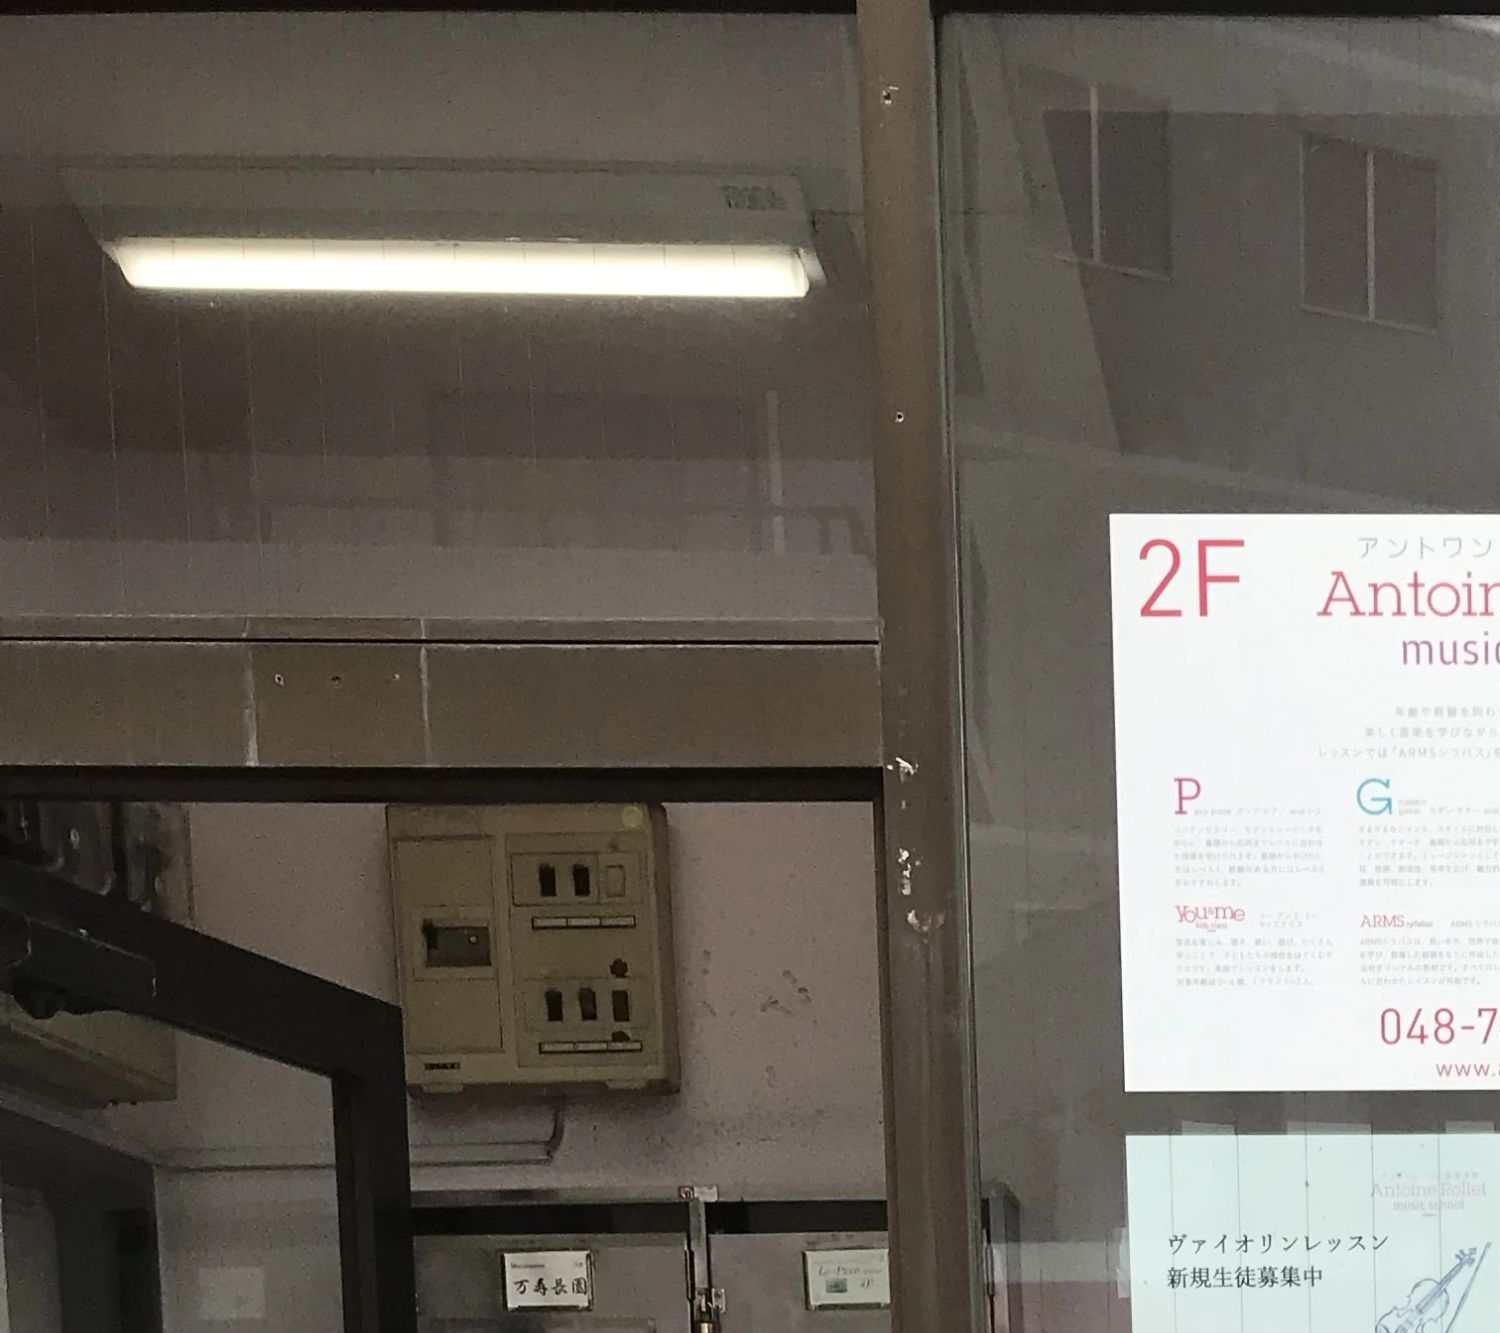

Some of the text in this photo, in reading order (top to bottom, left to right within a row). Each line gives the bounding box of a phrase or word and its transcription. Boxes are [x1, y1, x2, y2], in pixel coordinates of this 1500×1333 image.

[1138, 538, 1245, 619] 2F
[1174, 778, 1201, 815] P
[1356, 778, 1393, 816] G
[1360, 915, 1405, 929] ARMS
[1370, 1181, 1488, 1198] Antoine Rollet
[1167, 1230, 1391, 1256] ヴァイオリンレッスン
[1166, 1264, 1325, 1290] 新規生徒募集中
